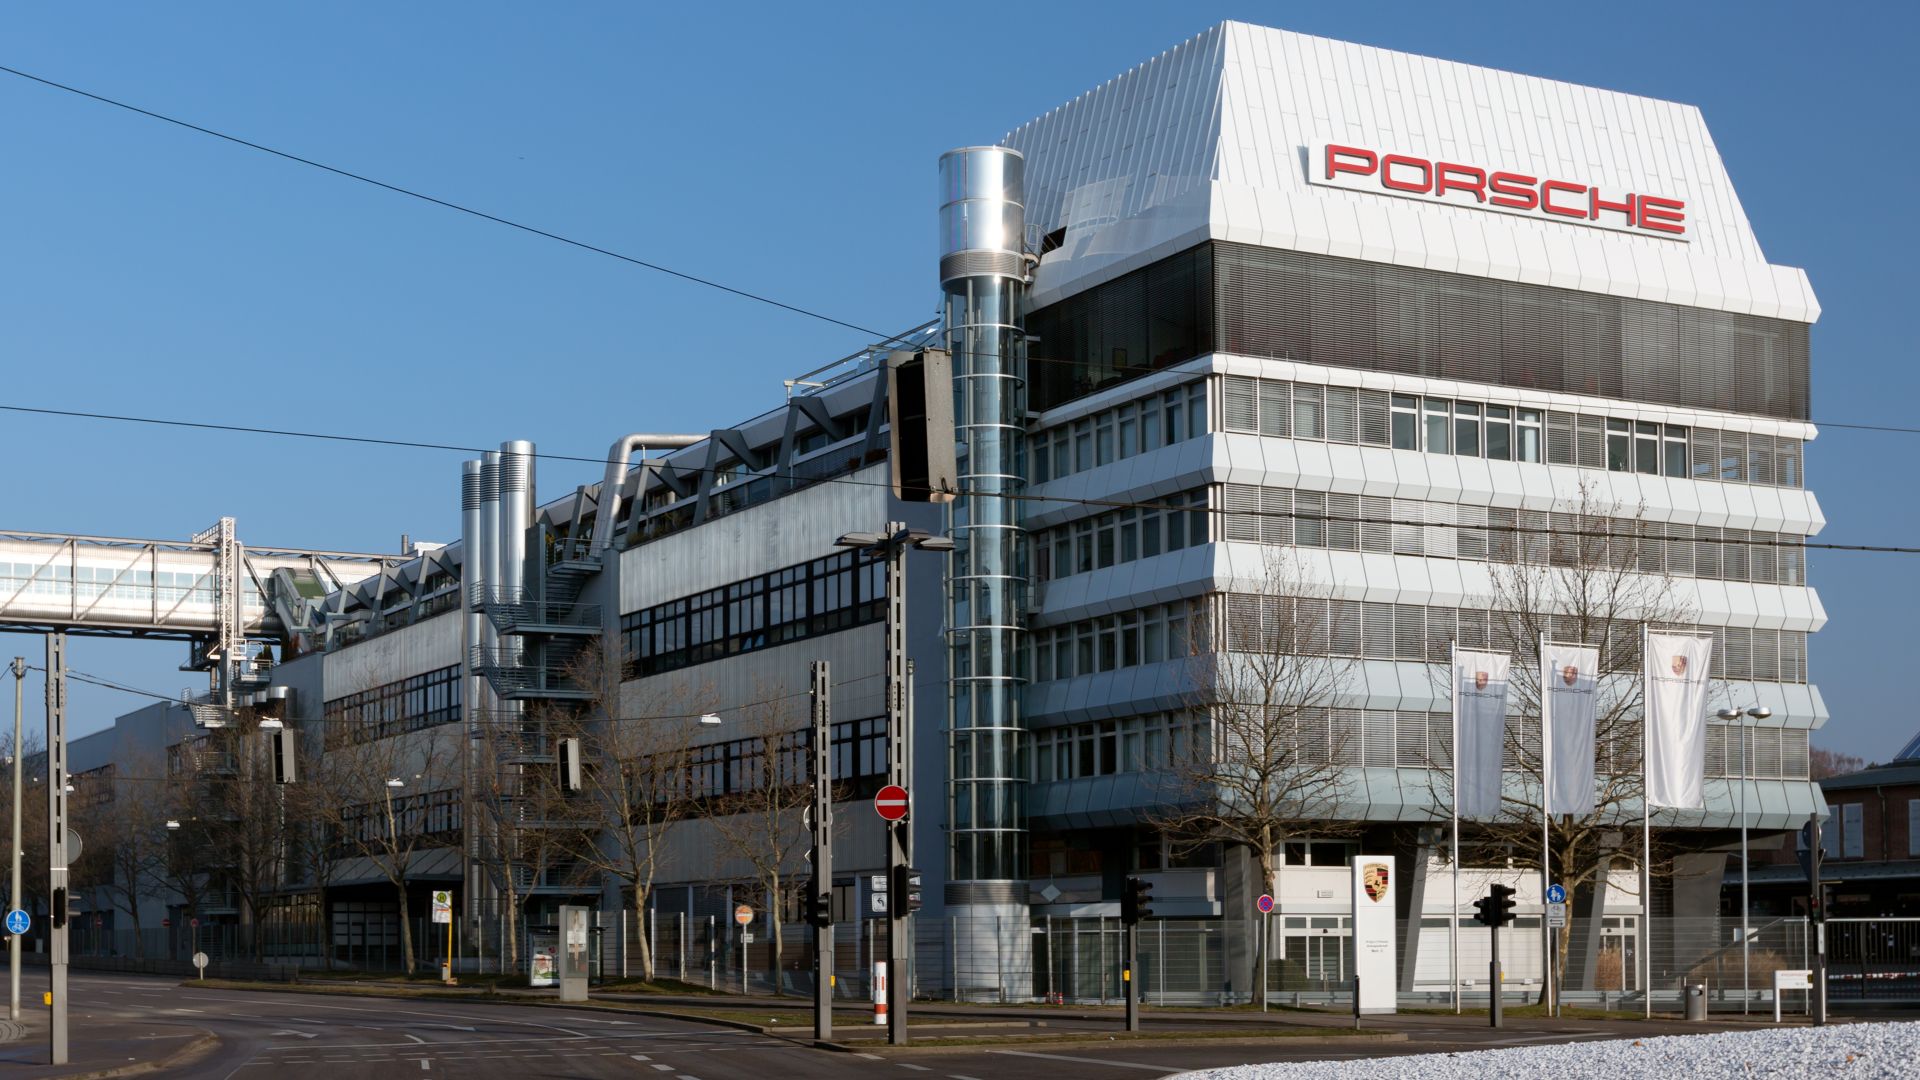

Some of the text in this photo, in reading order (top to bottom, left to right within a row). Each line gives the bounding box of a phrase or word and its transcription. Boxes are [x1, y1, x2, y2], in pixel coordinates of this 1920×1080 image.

[1325, 143, 1685, 234] PORSCHE
[1459, 691, 1504, 699] PORSCHE
[1547, 687, 1593, 695] PORSCHE
